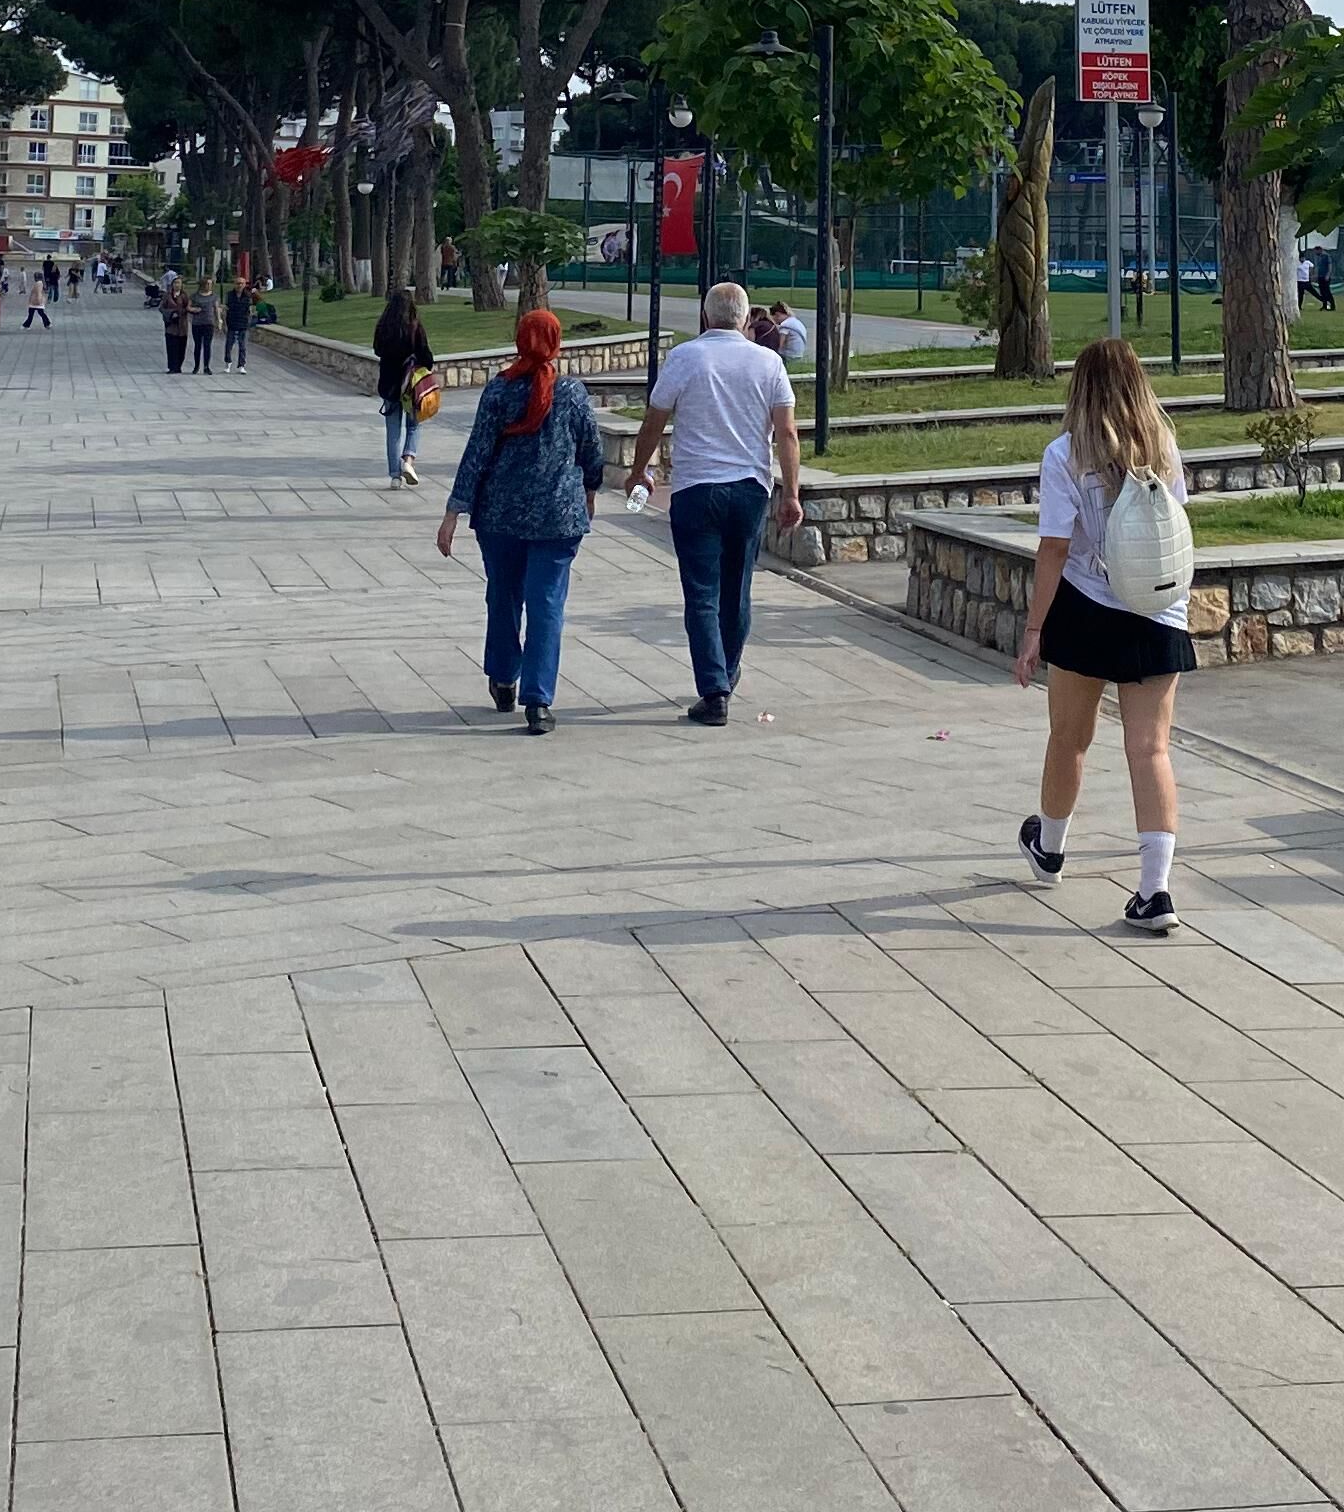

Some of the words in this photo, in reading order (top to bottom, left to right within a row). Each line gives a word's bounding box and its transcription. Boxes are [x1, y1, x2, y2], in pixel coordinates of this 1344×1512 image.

[1091, 1, 1136, 15] LÜTFEN
[1081, 17, 1115, 26] KABUKLU
[1116, 17, 1146, 27] YİYECEK
[1083, 27, 1093, 35] VE
[1094, 27, 1125, 37] ÇÖPLERİ
[1126, 29, 1144, 37] YERE
[1094, 37, 1133, 46] ATMAYINIZ
[1097, 56, 1133, 67] LÜTFEN
[1102, 72, 1129, 81] KÖPEK
[1092, 81, 1139, 91] DIŞKILARINI
[1092, 91, 1139, 100] TOPLAYINIZ
